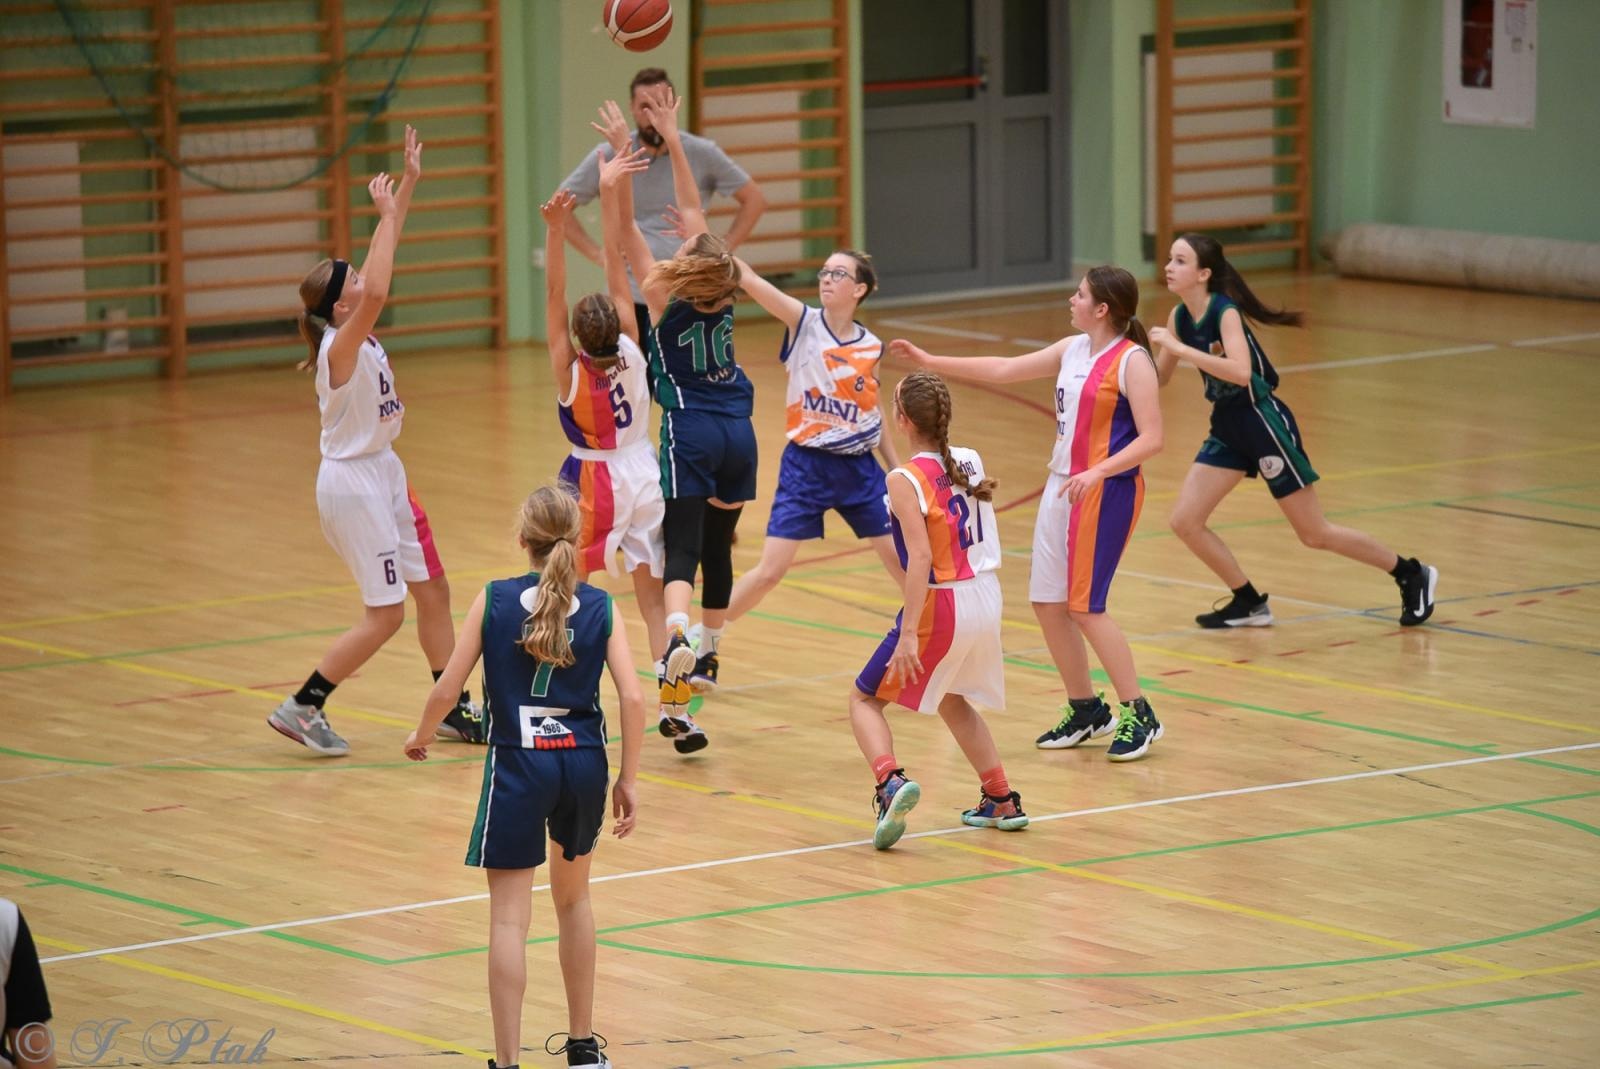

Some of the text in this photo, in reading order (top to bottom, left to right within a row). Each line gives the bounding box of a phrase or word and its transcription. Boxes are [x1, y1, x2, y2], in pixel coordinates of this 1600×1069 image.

[678, 314, 734, 373] 16
[854, 375, 865, 393] 8
[608, 382, 633, 430] 5
[802, 390, 860, 425] MINI
[383, 558, 397, 586] 6
[524, 624, 574, 697] 7
[541, 723, 562, 734] 1986
